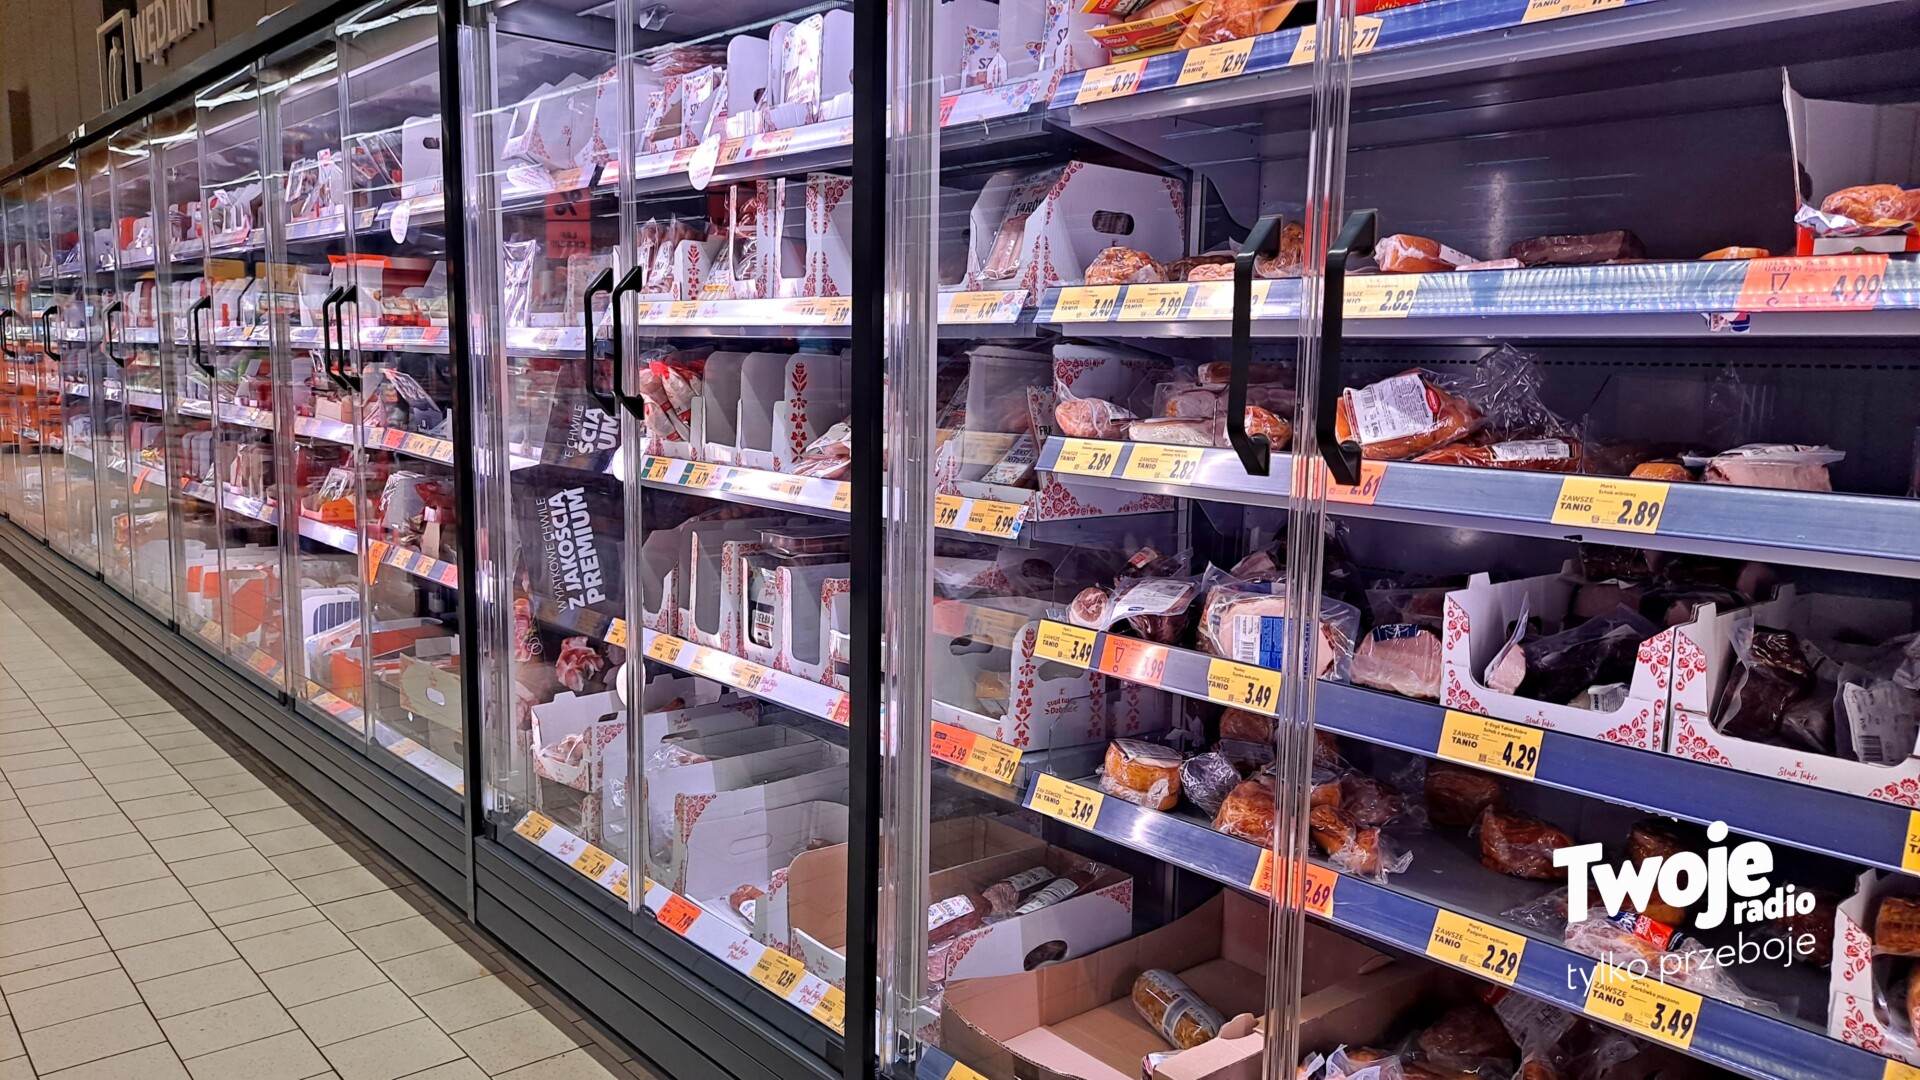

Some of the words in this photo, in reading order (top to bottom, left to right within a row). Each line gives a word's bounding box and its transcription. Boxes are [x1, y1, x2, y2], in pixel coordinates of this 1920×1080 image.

[1220, 52, 1248, 74] 12.99
[1111, 72, 1136, 93] 8.99
[1830, 273, 1881, 303] 4.99
[977, 302, 998, 319] 6.49
[1155, 296, 1182, 317] 2.99
[567, 403, 584, 450] CHWILE
[1087, 452, 1112, 472] 2.89
[1137, 462, 1157, 470] TANIO
[1139, 456, 1159, 464] ZAWSZE
[1169, 459, 1197, 480] 2.82
[1560, 502, 1592, 512] TANIO
[1561, 494, 1595, 504] ZAWSZE
[535, 497, 556, 542] CHWILE
[938, 507, 958, 525] 9.99
[1616, 499, 1661, 527] 2.89
[993, 514, 1014, 534] 9.99
[566, 486, 606, 605] PREMIUM
[568, 593, 586, 611] Z
[1042, 639, 1059, 648] TANIO
[1070, 640, 1092, 663] 3.49
[1208, 680, 1229, 691] TANIO
[1209, 673, 1231, 684] ZAWSZE
[1244, 682, 1272, 708] 3.49
[1451, 736, 1478, 749] TANIO
[1452, 729, 1480, 740] ZAWSZE
[949, 745, 967, 761] 2.99
[1502, 741, 1537, 772] 4.29
[994, 757, 1016, 779] 5.99
[1043, 795, 1060, 806] TANIO
[1071, 799, 1094, 823] 3.49
[1434, 933, 1461, 949] TANIO
[1435, 926, 1464, 941] ZAWSZE
[1481, 944, 1518, 976] 2.29
[1592, 989, 1625, 1007] TANIO
[1593, 981, 1628, 998] ZAWSZE
[1650, 1002, 1693, 1039] 3.49
